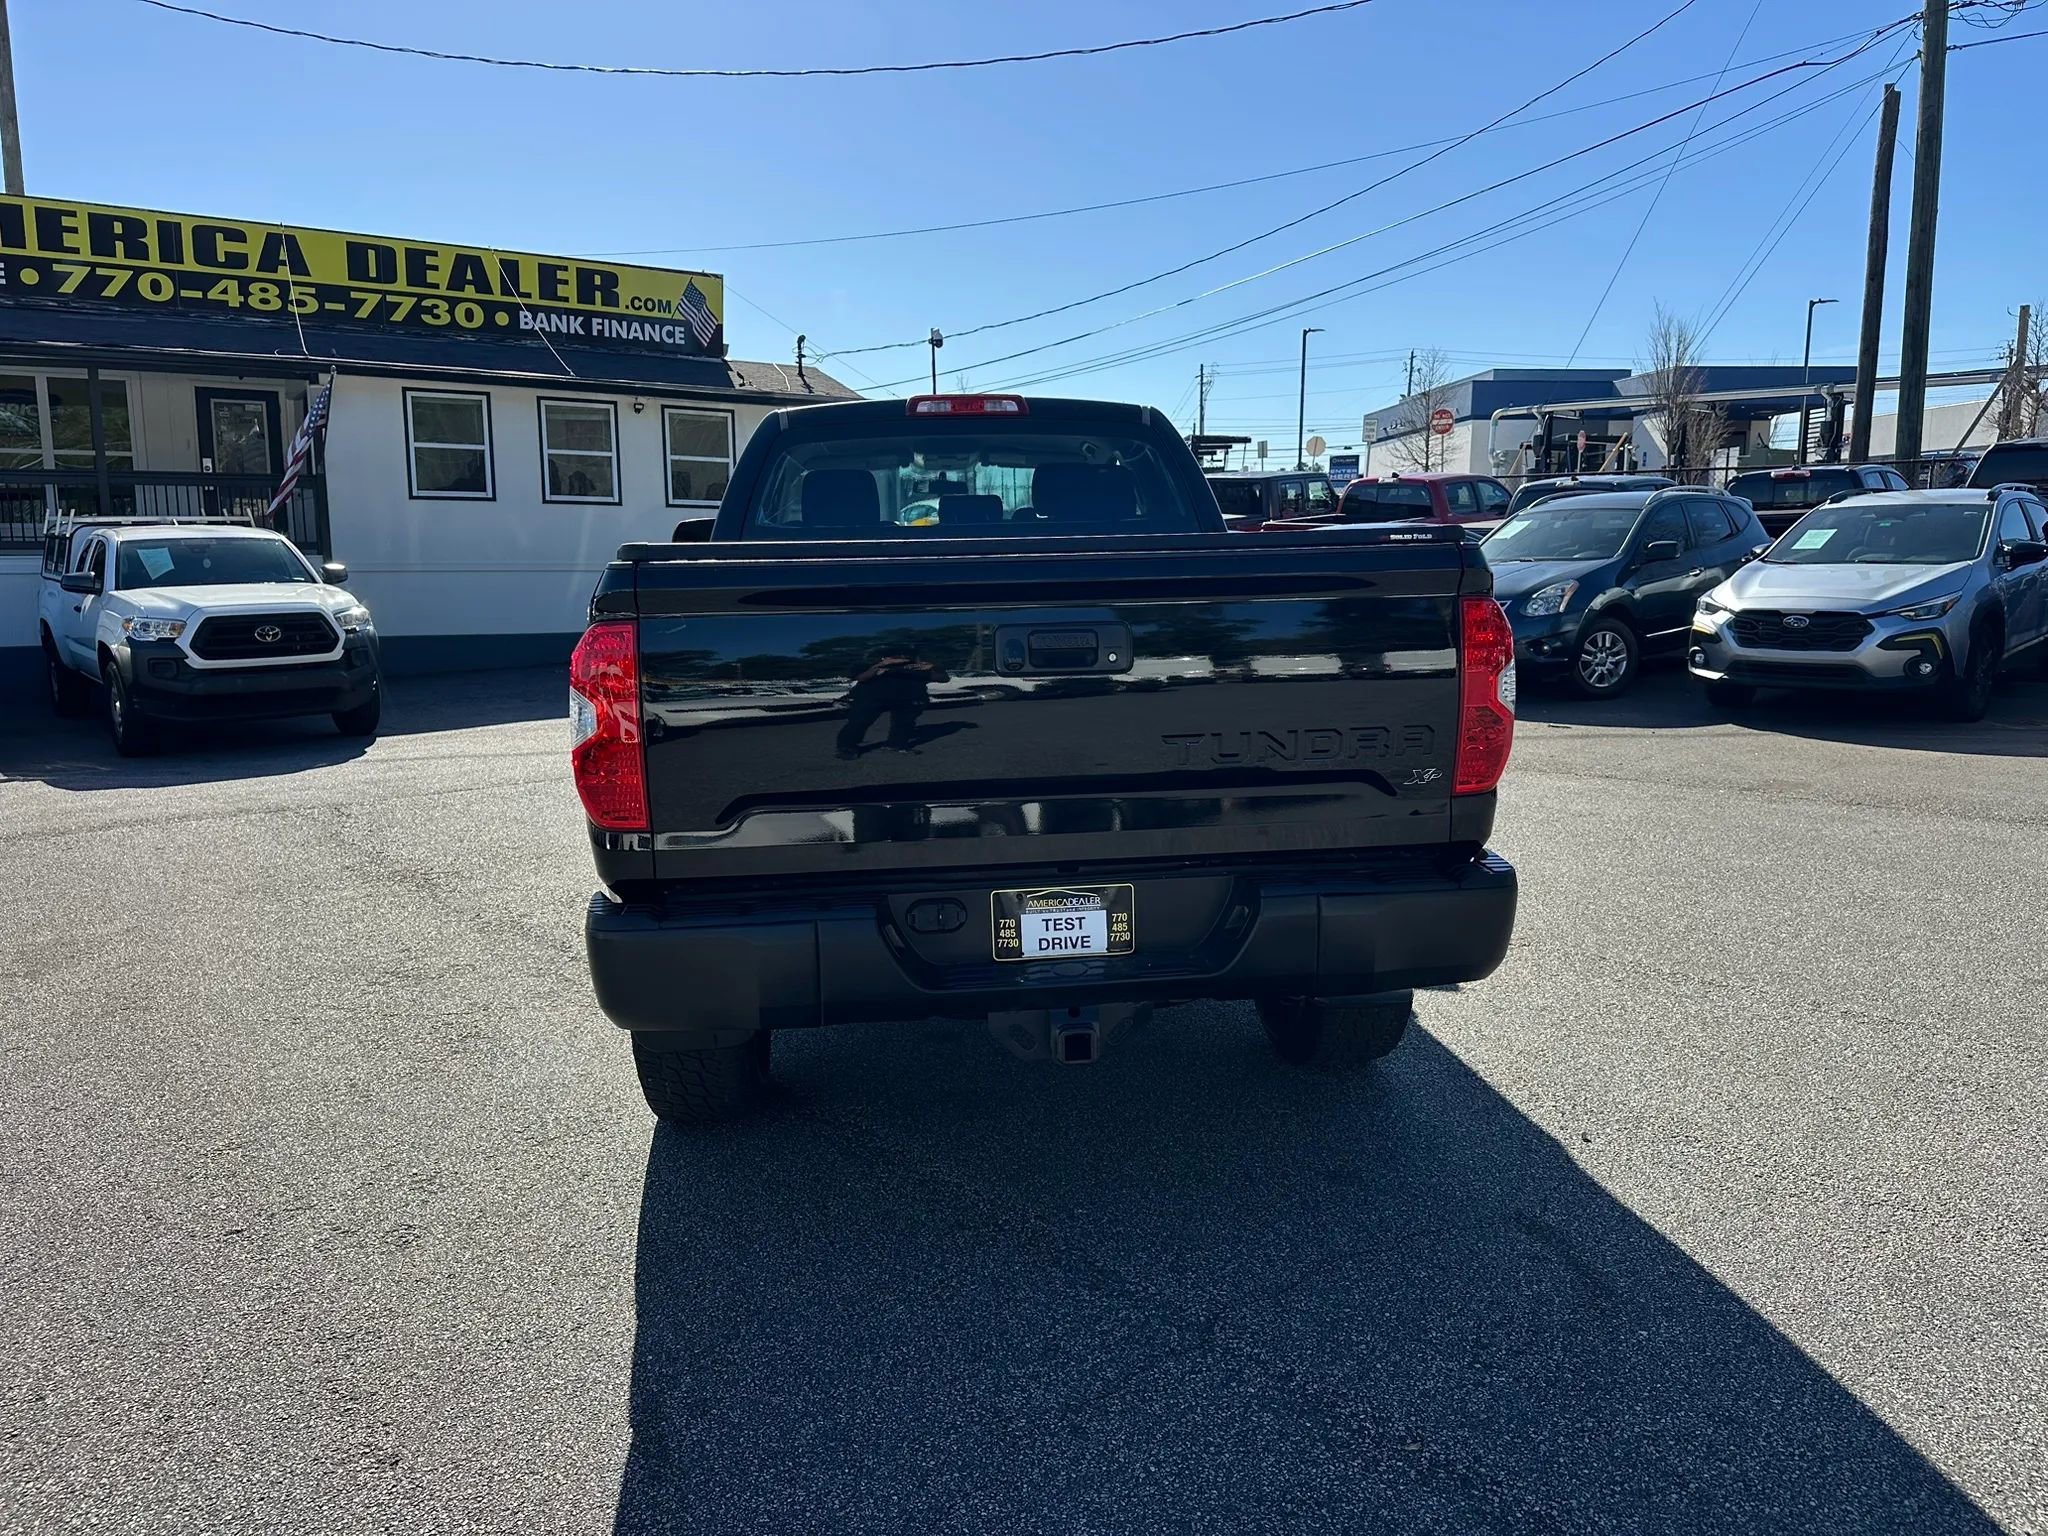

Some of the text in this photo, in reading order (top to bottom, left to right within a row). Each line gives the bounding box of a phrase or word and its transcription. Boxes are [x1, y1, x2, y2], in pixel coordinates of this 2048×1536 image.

[51, 262, 686, 346] 770-485-7730 BANK FINANCE
[1161, 724, 1436, 767] TUNDRA
[1111, 912, 1128, 922] 770
[999, 918, 1016, 928] 770
[1042, 917, 1086, 932] TEST
[1112, 922, 1128, 932] 485
[999, 928, 1016, 938] 485
[1110, 931, 1131, 942] 7730
[997, 938, 1019, 948] 7730
[1038, 936, 1091, 951] DRIVE
